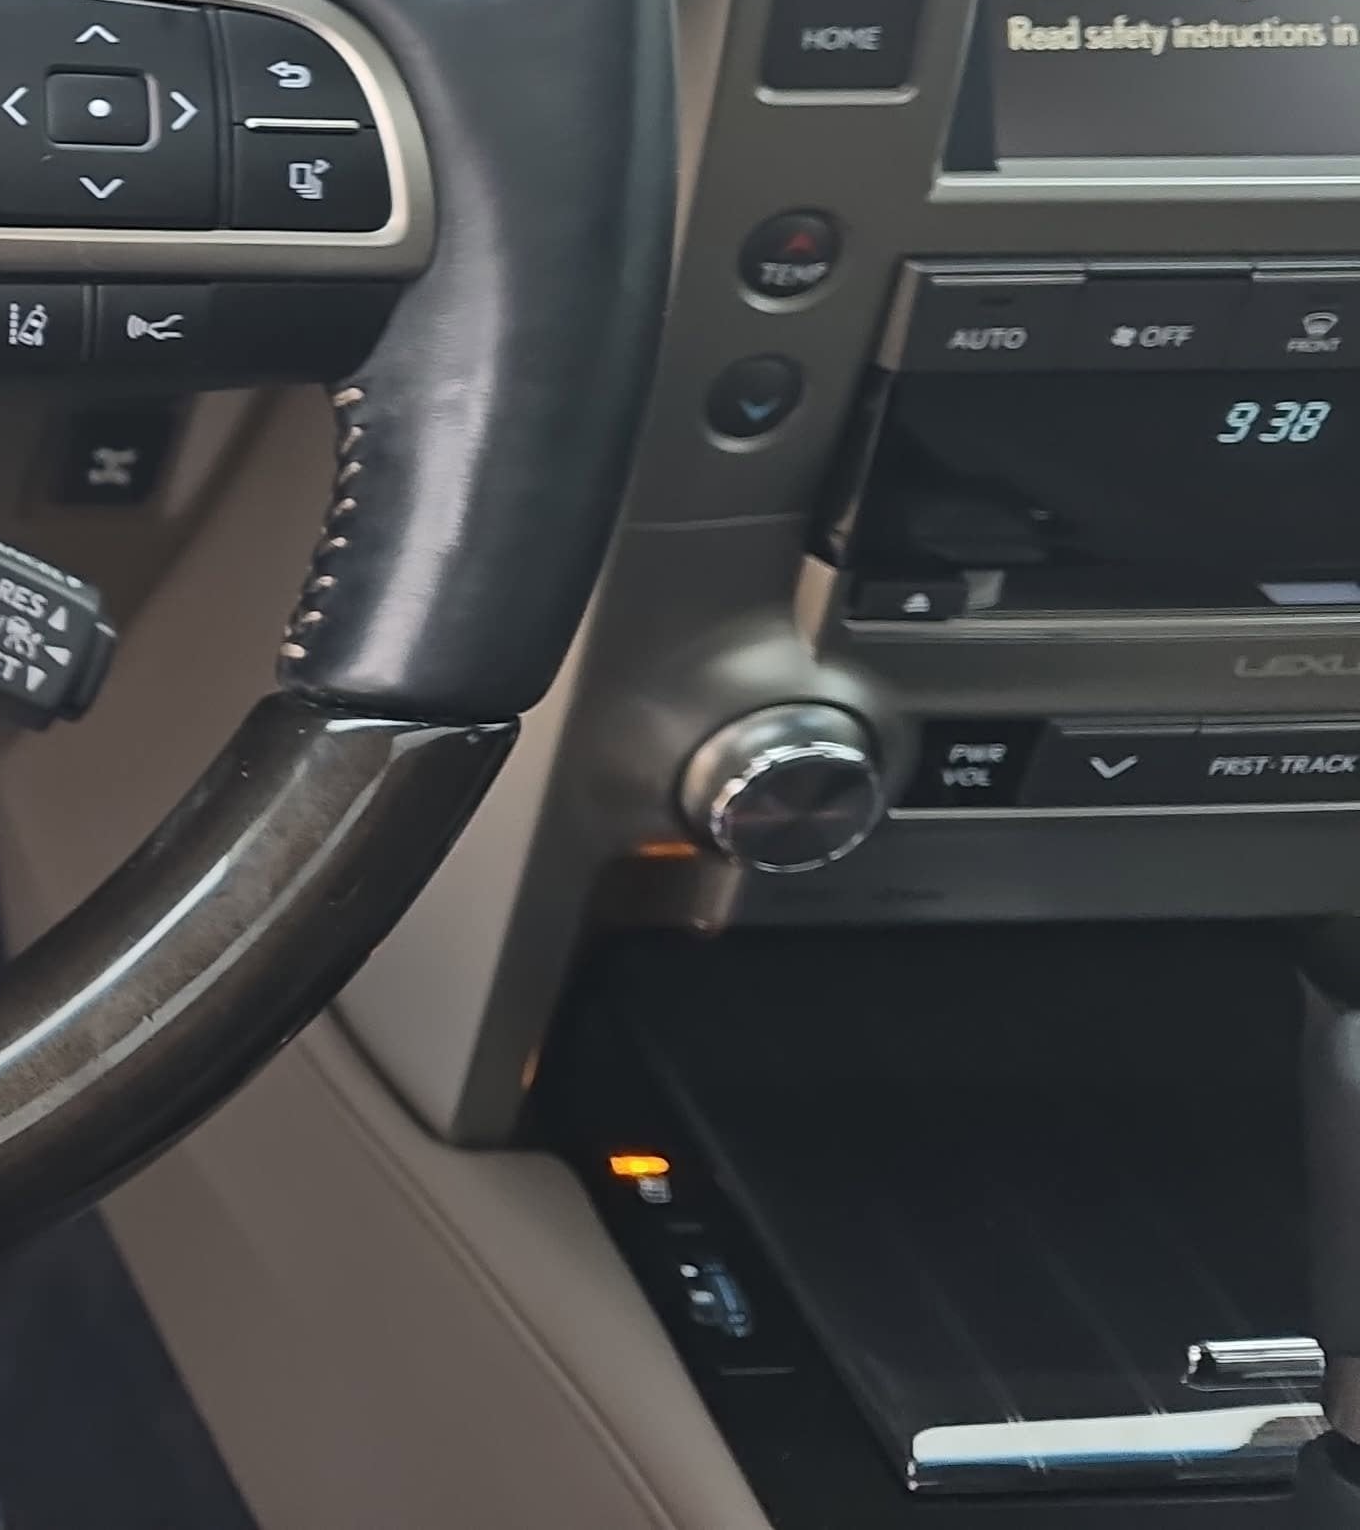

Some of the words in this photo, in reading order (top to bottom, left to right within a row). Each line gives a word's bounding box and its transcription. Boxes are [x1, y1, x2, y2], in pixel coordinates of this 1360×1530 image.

[800, 26, 882, 51] HOME
[1007, 15, 1081, 51] Read
[1084, 14, 1168, 56] safety
[1172, 16, 1327, 49] instructions
[945, 327, 1029, 350] AUTO
[1139, 325, 1197, 348] OFF
[949, 742, 1008, 764] PWR
[943, 766, 993, 787] VOL
